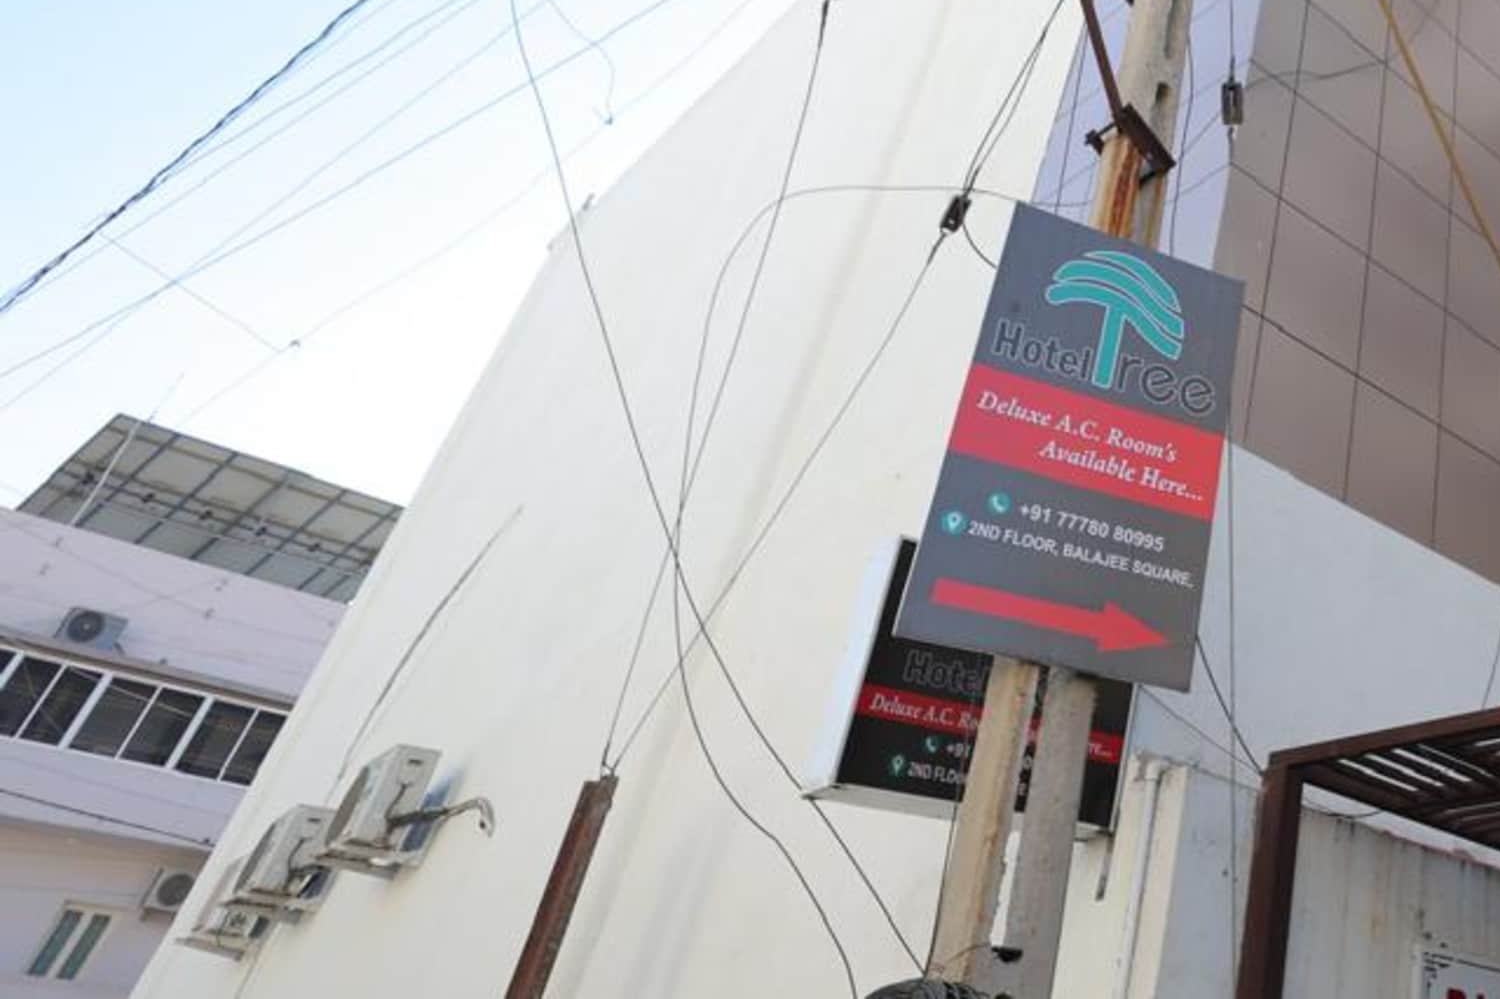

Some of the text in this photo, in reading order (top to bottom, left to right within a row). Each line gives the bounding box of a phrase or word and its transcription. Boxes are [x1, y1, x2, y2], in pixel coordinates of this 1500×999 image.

[992, 316, 1094, 382] Hotel
[976, 391, 1178, 462] Deluxe A.C. Room's
[1039, 440, 1137, 482] Available
[968, 520, 1001, 540] 2ND
[1063, 543, 1129, 572] BALAJEE
[1019, 503, 1165, 552] +91 77780 80995
[870, 693, 921, 720] Deluxe
